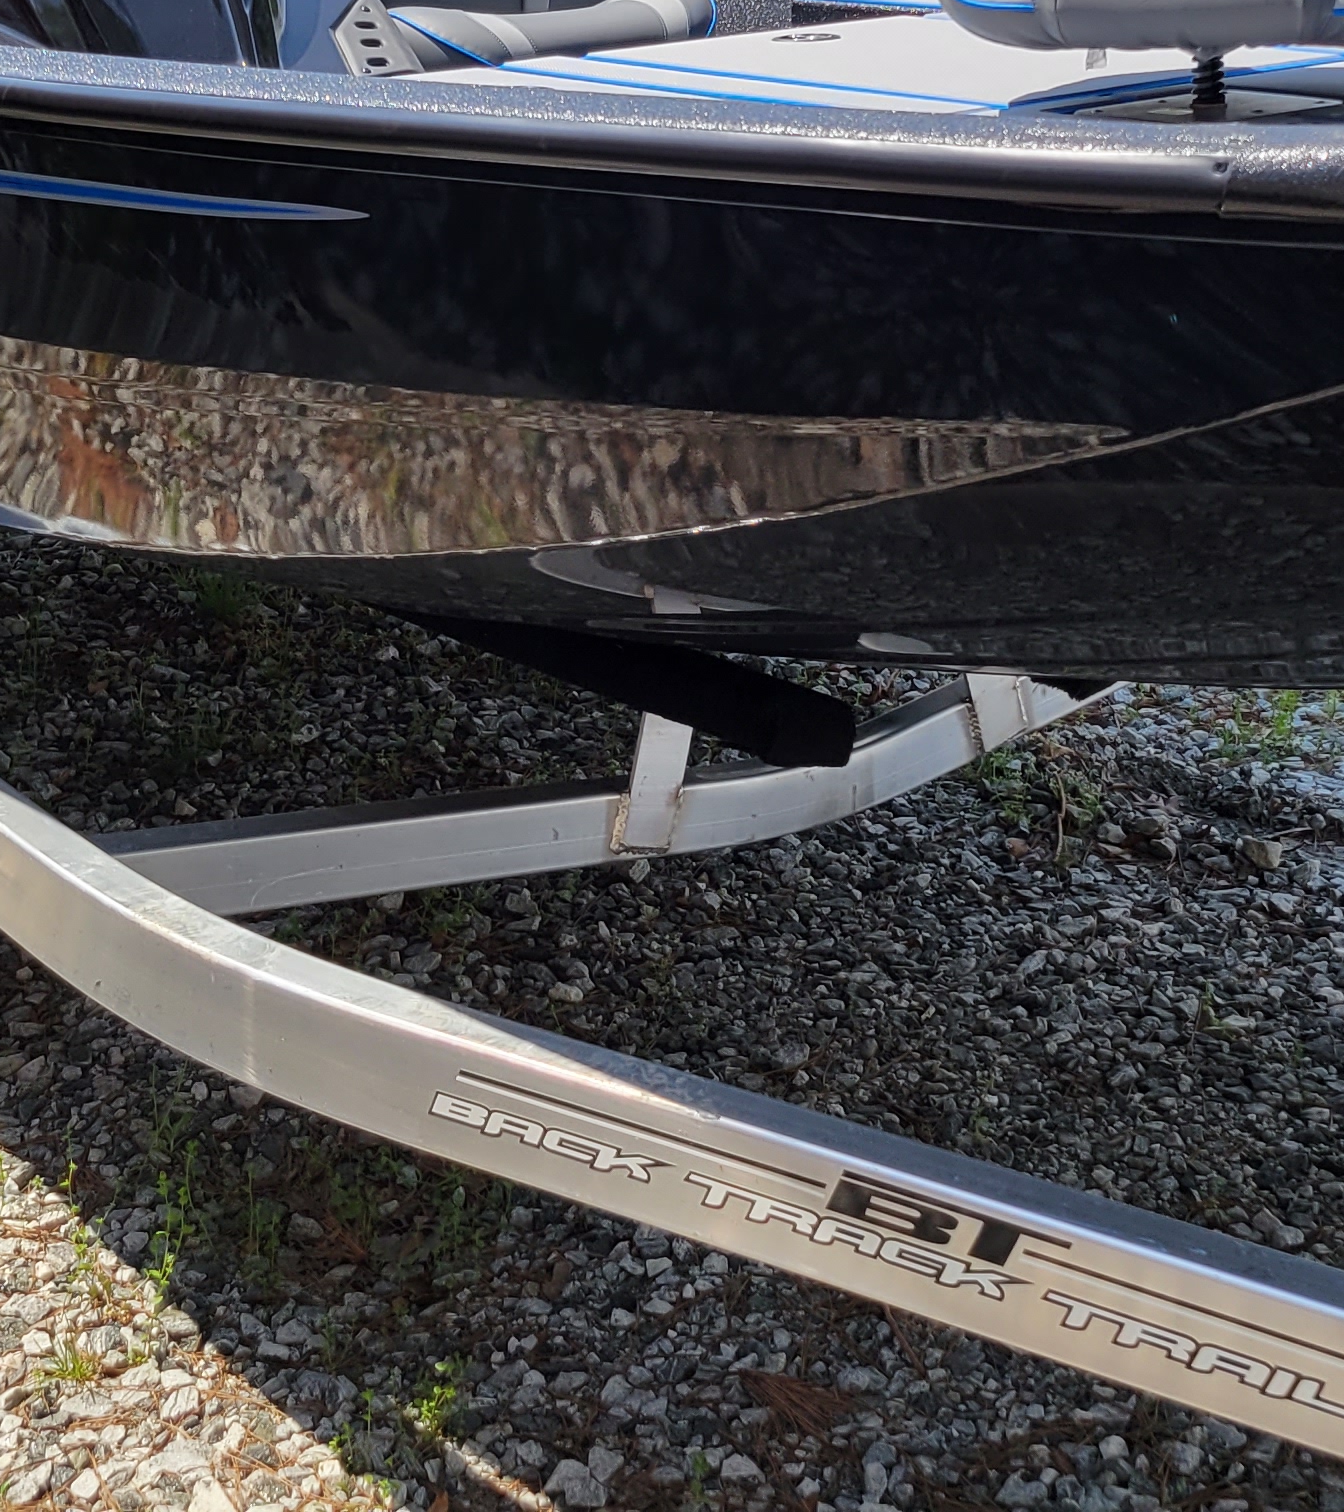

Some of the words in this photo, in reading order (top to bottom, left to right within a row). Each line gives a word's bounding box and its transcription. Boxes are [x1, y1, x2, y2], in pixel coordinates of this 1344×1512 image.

[427, 1090, 675, 1183] BACK
[683, 1170, 1034, 1301] TRACK
[826, 1169, 1072, 1266] BT
